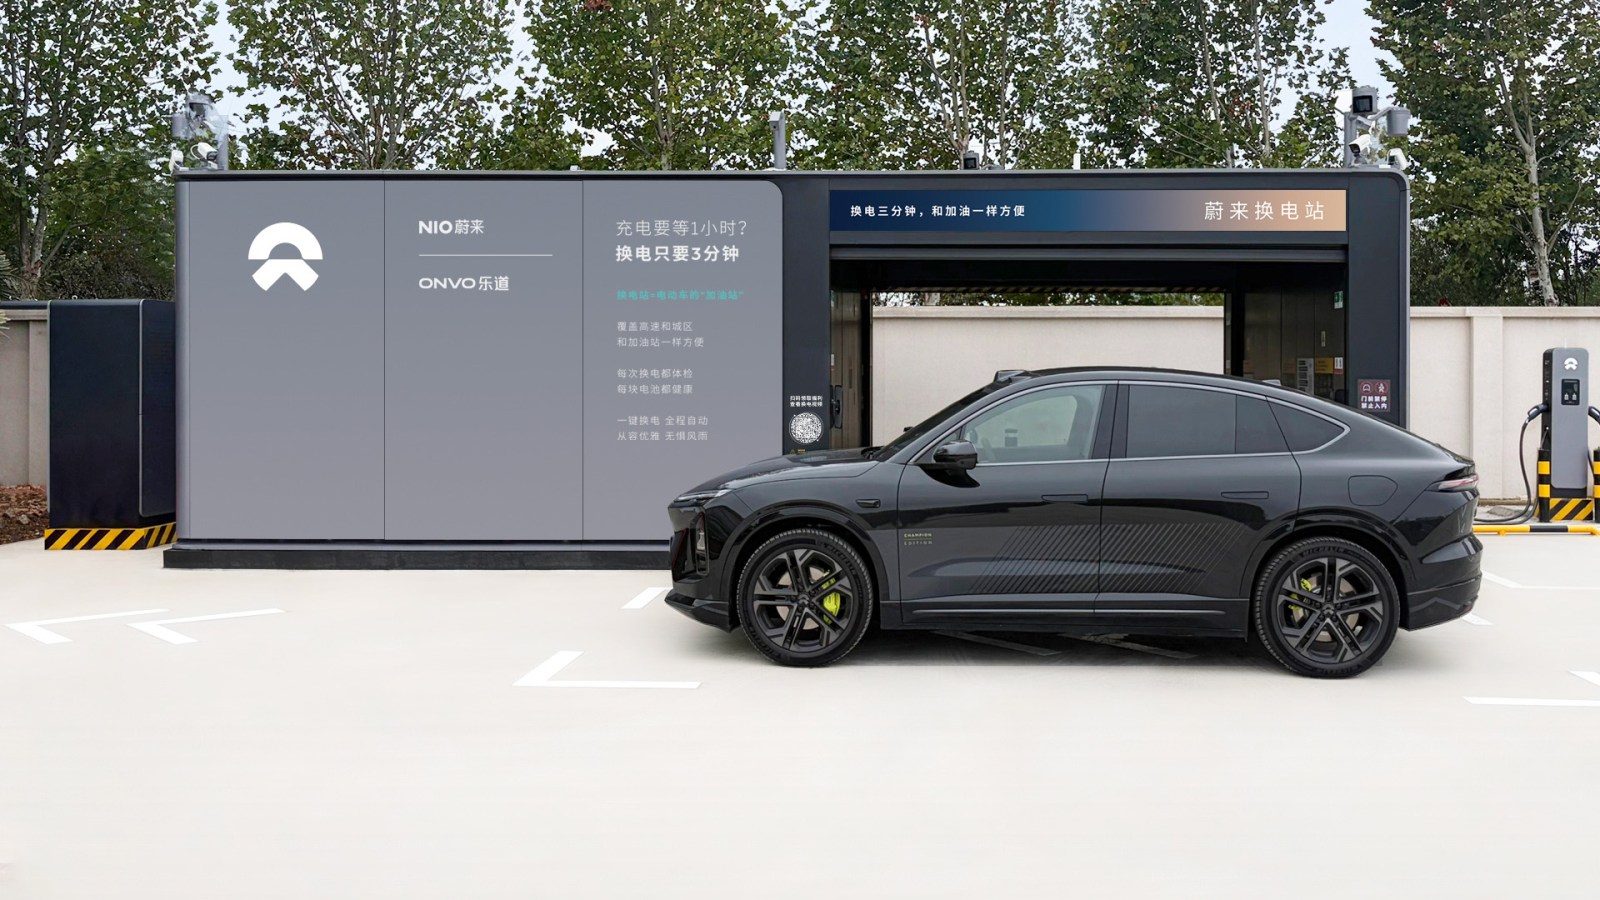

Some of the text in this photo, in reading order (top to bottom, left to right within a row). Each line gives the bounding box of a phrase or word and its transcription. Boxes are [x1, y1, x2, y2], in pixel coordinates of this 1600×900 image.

[850, 205, 1026, 217] 换电三分钟，和加油一样方便
[1204, 200, 1324, 221] 蔚来换电站
[615, 244, 740, 262] 换电只要3分钟
[617, 321, 693, 332] 覆盖高速和城区
[617, 337, 704, 348] 和加油站一样方便
[617, 368, 693, 379] 每次换电都体检
[617, 384, 693, 394] 每块电池都健康
[617, 415, 708, 426] 一键换电 全程自动
[617, 431, 708, 441] 从容优雅 无惧风雨
